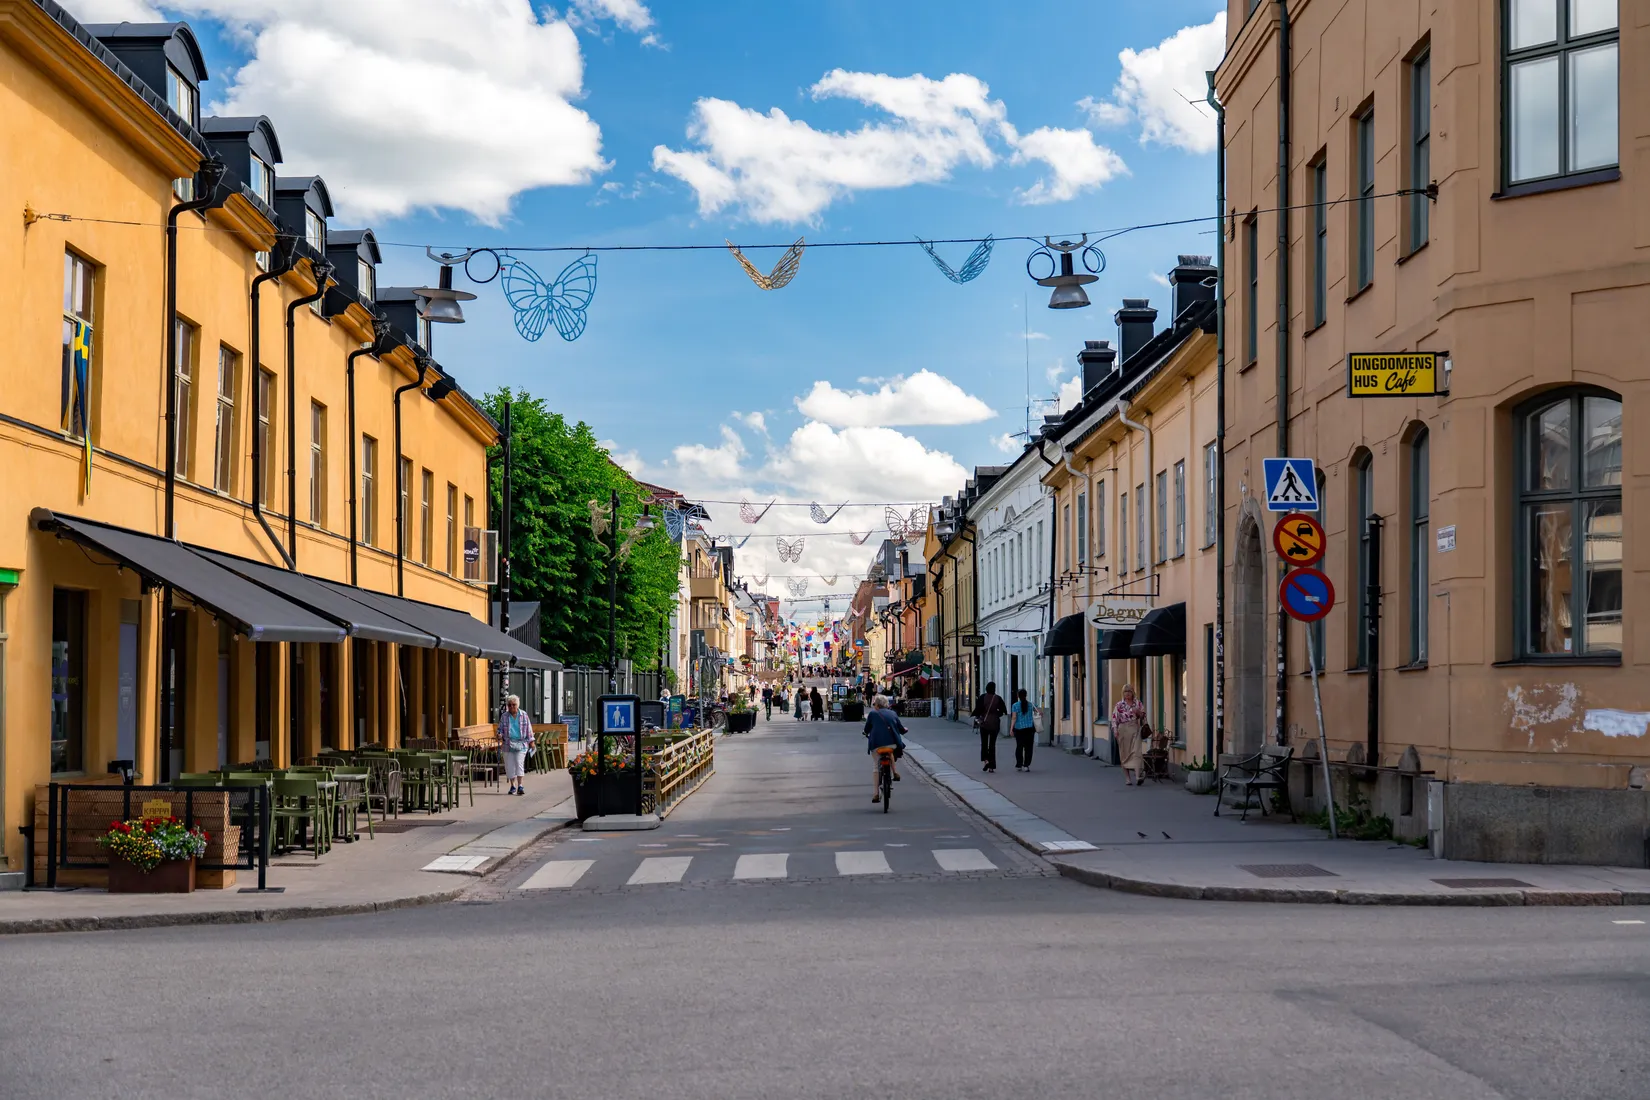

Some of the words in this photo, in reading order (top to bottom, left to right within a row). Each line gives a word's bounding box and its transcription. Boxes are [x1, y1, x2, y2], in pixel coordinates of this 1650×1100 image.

[1353, 356, 1432, 371] UNGDOMENS
[1354, 375, 1378, 388] HUS
[1385, 369, 1418, 392] Café
[1096, 604, 1147, 622] Dagny
[143, 807, 170, 815] KAPPA
